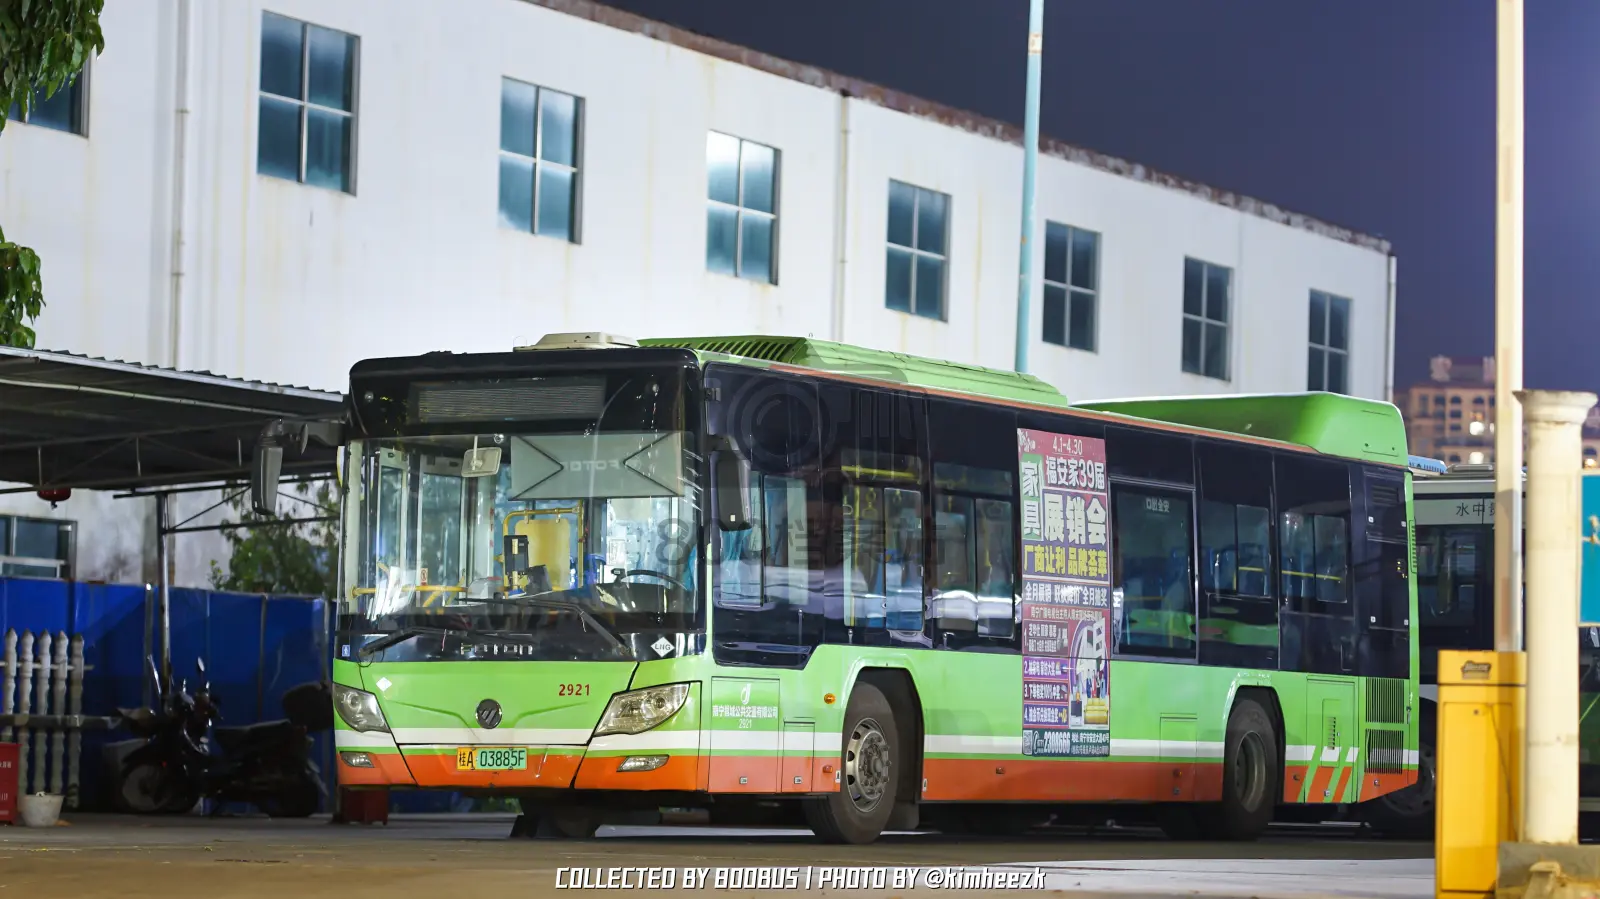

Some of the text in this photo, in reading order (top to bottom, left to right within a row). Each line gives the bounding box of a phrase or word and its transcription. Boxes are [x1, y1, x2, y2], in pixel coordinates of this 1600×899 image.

[1052, 436, 1083, 456] 4.1-4.30
[1021, 461, 1041, 536] 家具
[1044, 493, 1107, 546] 展销会
[1024, 544, 1108, 578] 厂商让利 品牌荟萃
[654, 643, 671, 651] LNG
[559, 683, 591, 697] 2921
[480, 750, 526, 767] 03885F
